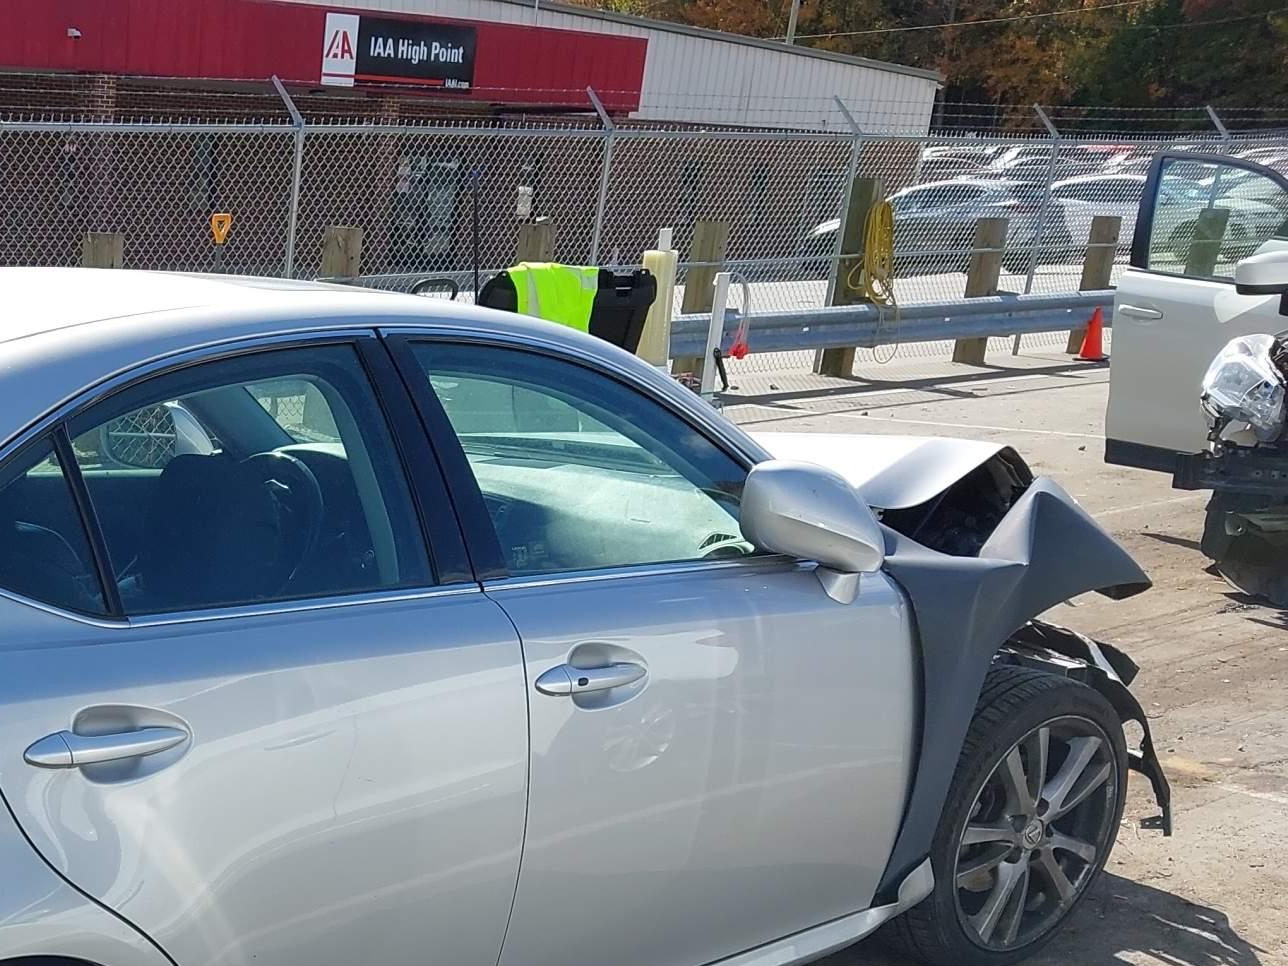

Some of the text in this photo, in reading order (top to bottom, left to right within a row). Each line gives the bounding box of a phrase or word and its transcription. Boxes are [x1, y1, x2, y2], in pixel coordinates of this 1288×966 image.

[370, 36, 464, 64] IAA High Point
